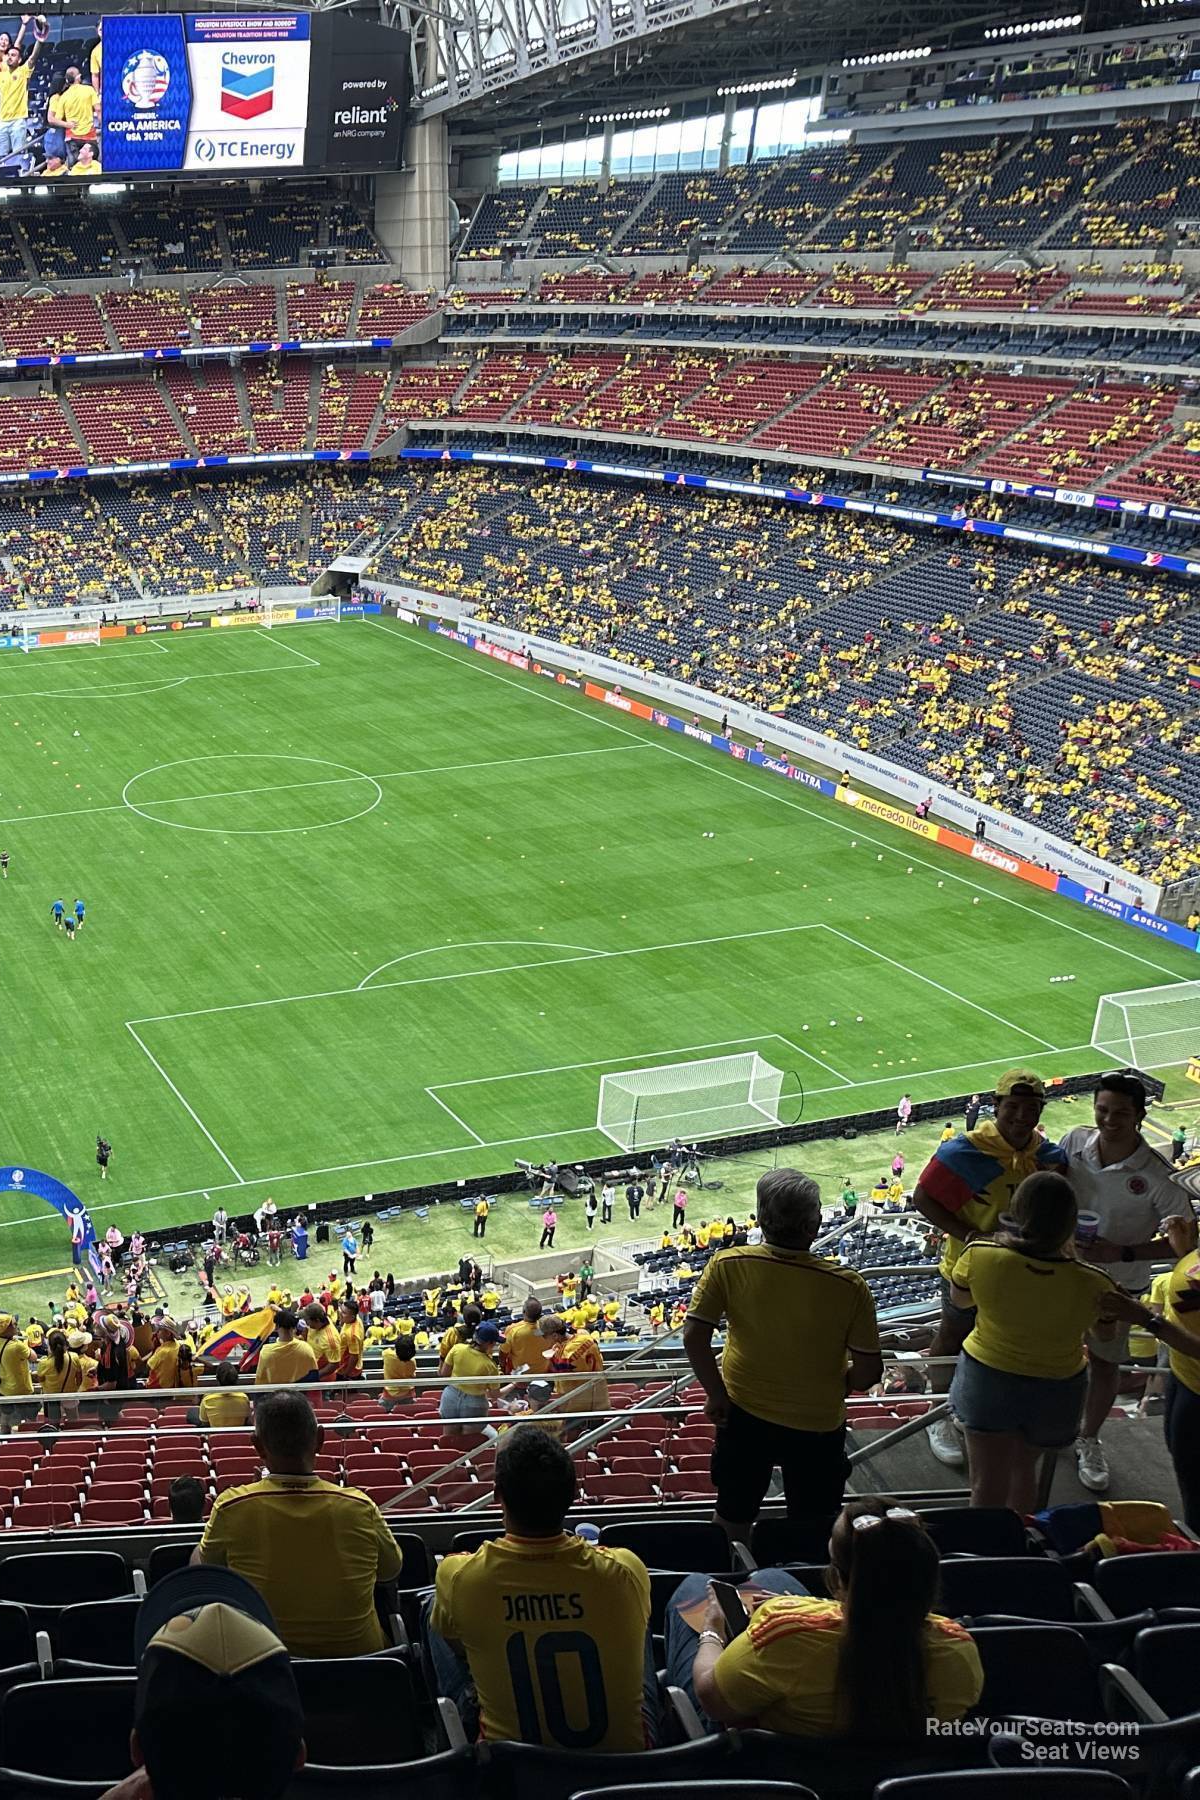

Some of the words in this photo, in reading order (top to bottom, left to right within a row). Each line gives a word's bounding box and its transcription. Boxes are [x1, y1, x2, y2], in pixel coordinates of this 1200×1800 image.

[222, 51, 275, 64] Chevron
[342, 80, 377, 91] powered
[377, 80, 387, 90] by
[334, 106, 387, 124] reliant
[108, 121, 136, 132] COPA
[136, 119, 181, 131] AMERICA
[357, 130, 385, 138] company
[125, 133, 142, 141] USA
[217, 142, 238, 156] TC
[240, 141, 295, 159] Energy
[684, 724, 712, 743] HOUSTON
[794, 768, 821, 789] ULTRA
[862, 798, 905, 825] mercado
[906, 815, 929, 835] libre
[937, 793, 963, 811] CONMEBOL
[964, 804, 978, 818] COPA
[977, 811, 1000, 827] AMERICA
[1000, 822, 1011, 833] USA
[1011, 826, 1024, 838] 2024
[970, 841, 1020, 874] Betano
[1044, 842, 1074, 862] CONMEBOL
[1074, 856, 1090, 870] COPA
[1089, 862, 1115, 881] AMERICA
[1115, 876, 1127, 889] USA
[1127, 882, 1143, 895] 2024
[1093, 894, 1123, 912] LATAM
[1139, 916, 1168, 933] DELTA
[502, 1593, 585, 1621] JAMES
[506, 1630, 609, 1749] 10
